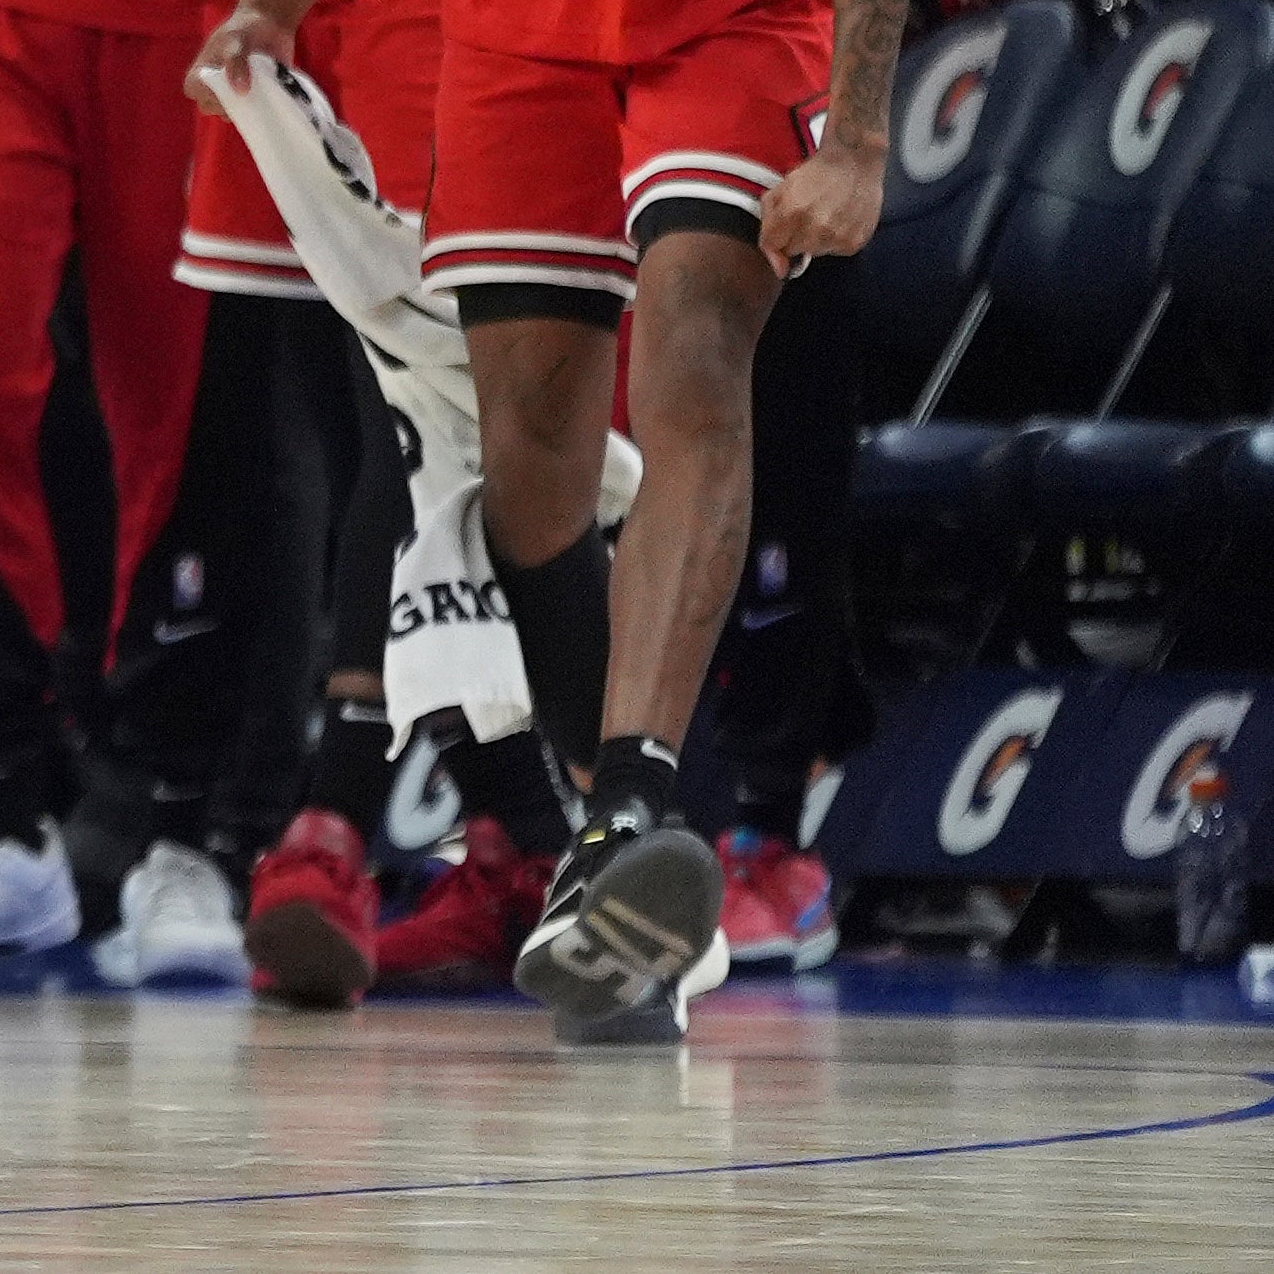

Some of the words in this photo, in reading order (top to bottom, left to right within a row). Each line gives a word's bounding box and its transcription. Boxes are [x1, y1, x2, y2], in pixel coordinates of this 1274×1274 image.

[900, 22, 1010, 183] G
[1109, 20, 1216, 176] G
[937, 686, 1065, 856] G
